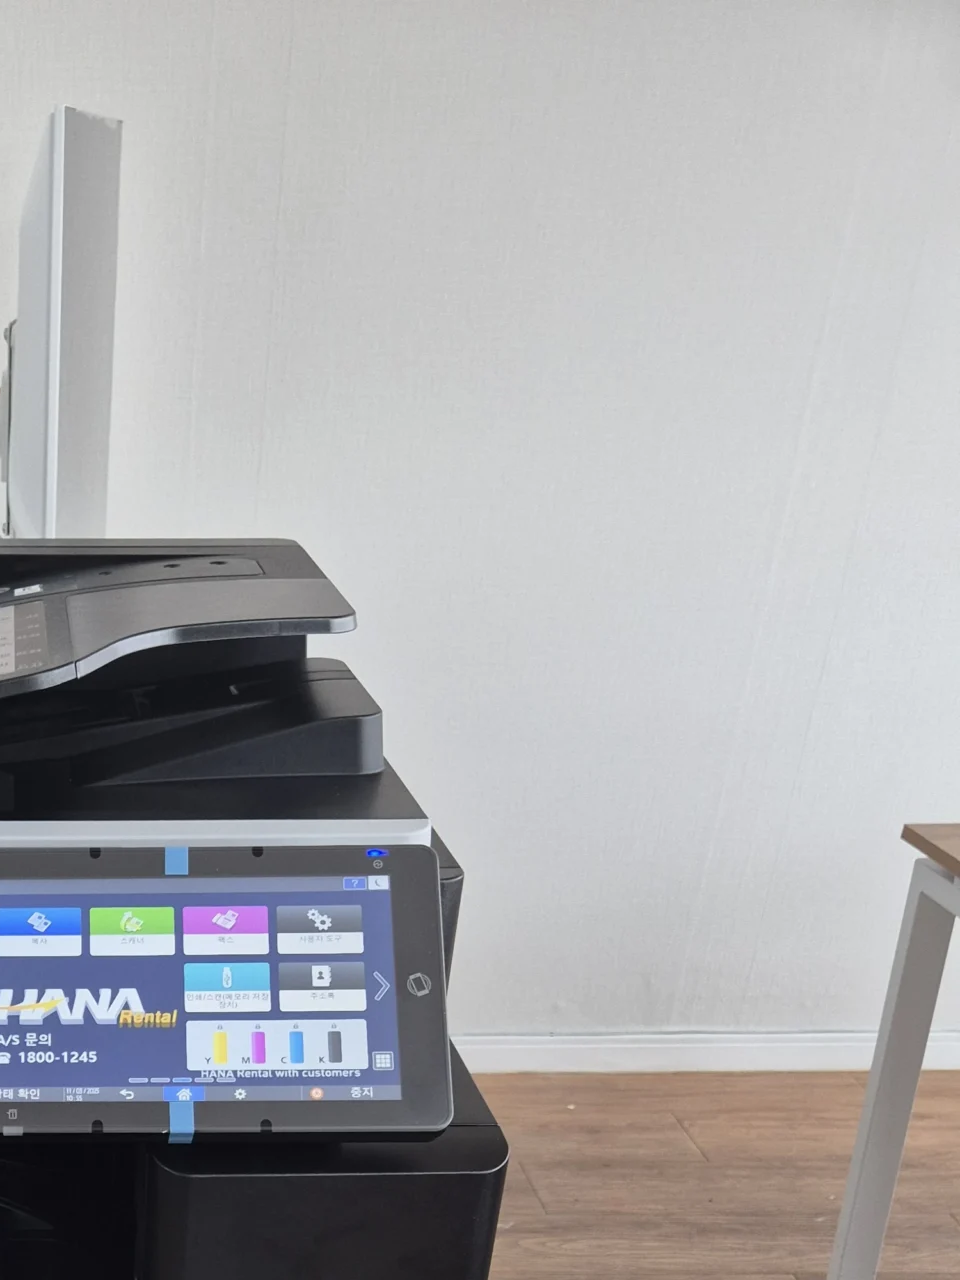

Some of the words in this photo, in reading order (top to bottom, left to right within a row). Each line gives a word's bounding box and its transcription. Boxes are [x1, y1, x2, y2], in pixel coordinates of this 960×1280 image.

[120, 937, 145, 945] 스캐너
[299, 935, 324, 943] 사용자
[326, 934, 343, 943] 도구
[310, 992, 335, 1000] 주소록
[118, 1009, 178, 1029] Rental
[24, 1032, 52, 1047] 문의
[18, 1051, 98, 1064] 1800-1245
[204, 1057, 212, 1065] Y
[280, 1056, 287, 1064] C
[318, 1056, 326, 1064] K
[200, 1069, 235, 1078] HANA
[236, 1069, 273, 1078] Rental
[275, 1069, 299, 1078] with
[302, 1069, 361, 1078] customers
[17, 1088, 40, 1100] 확인
[350, 1087, 374, 1098] 중지
